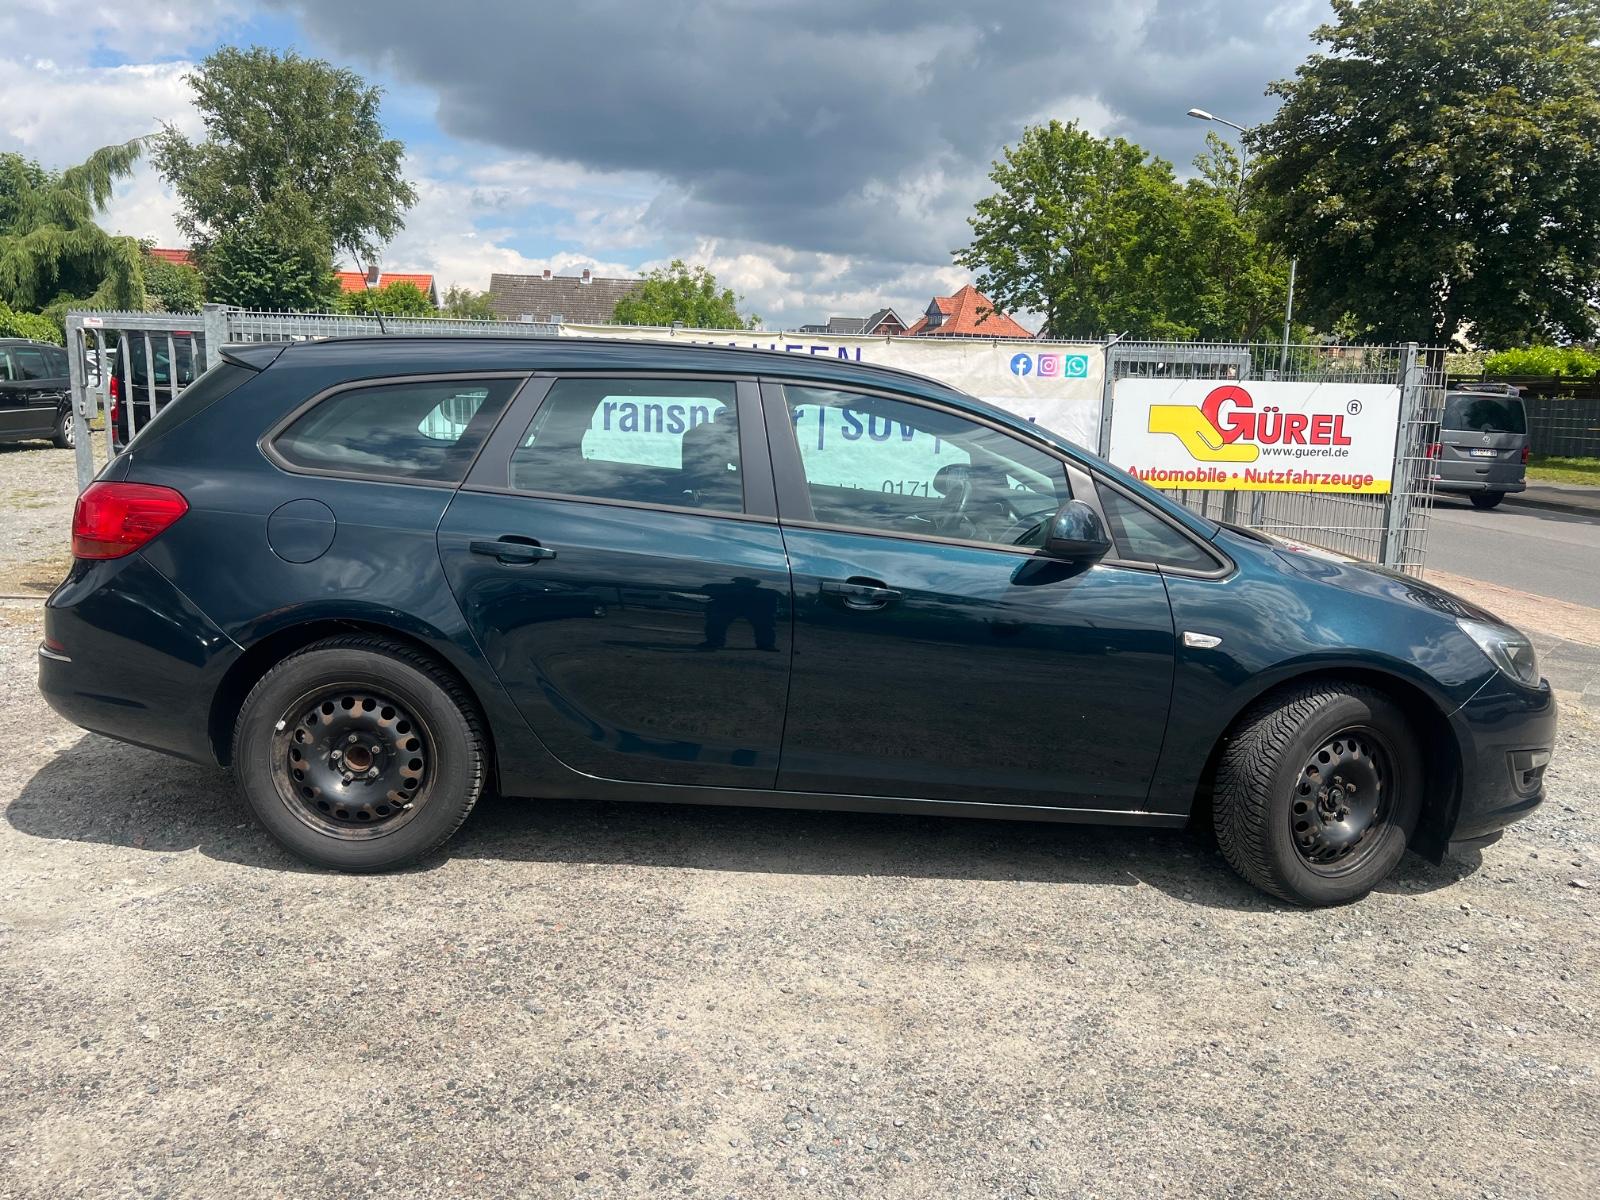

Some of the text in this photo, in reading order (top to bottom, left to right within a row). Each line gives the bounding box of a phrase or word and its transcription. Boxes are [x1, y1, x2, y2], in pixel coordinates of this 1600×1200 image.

[1201, 385, 1352, 446] GÜREL
[1261, 447, 1349, 459] www.guerel.de
[1128, 465, 1374, 490] Automobile Nutzfahrzeuge
